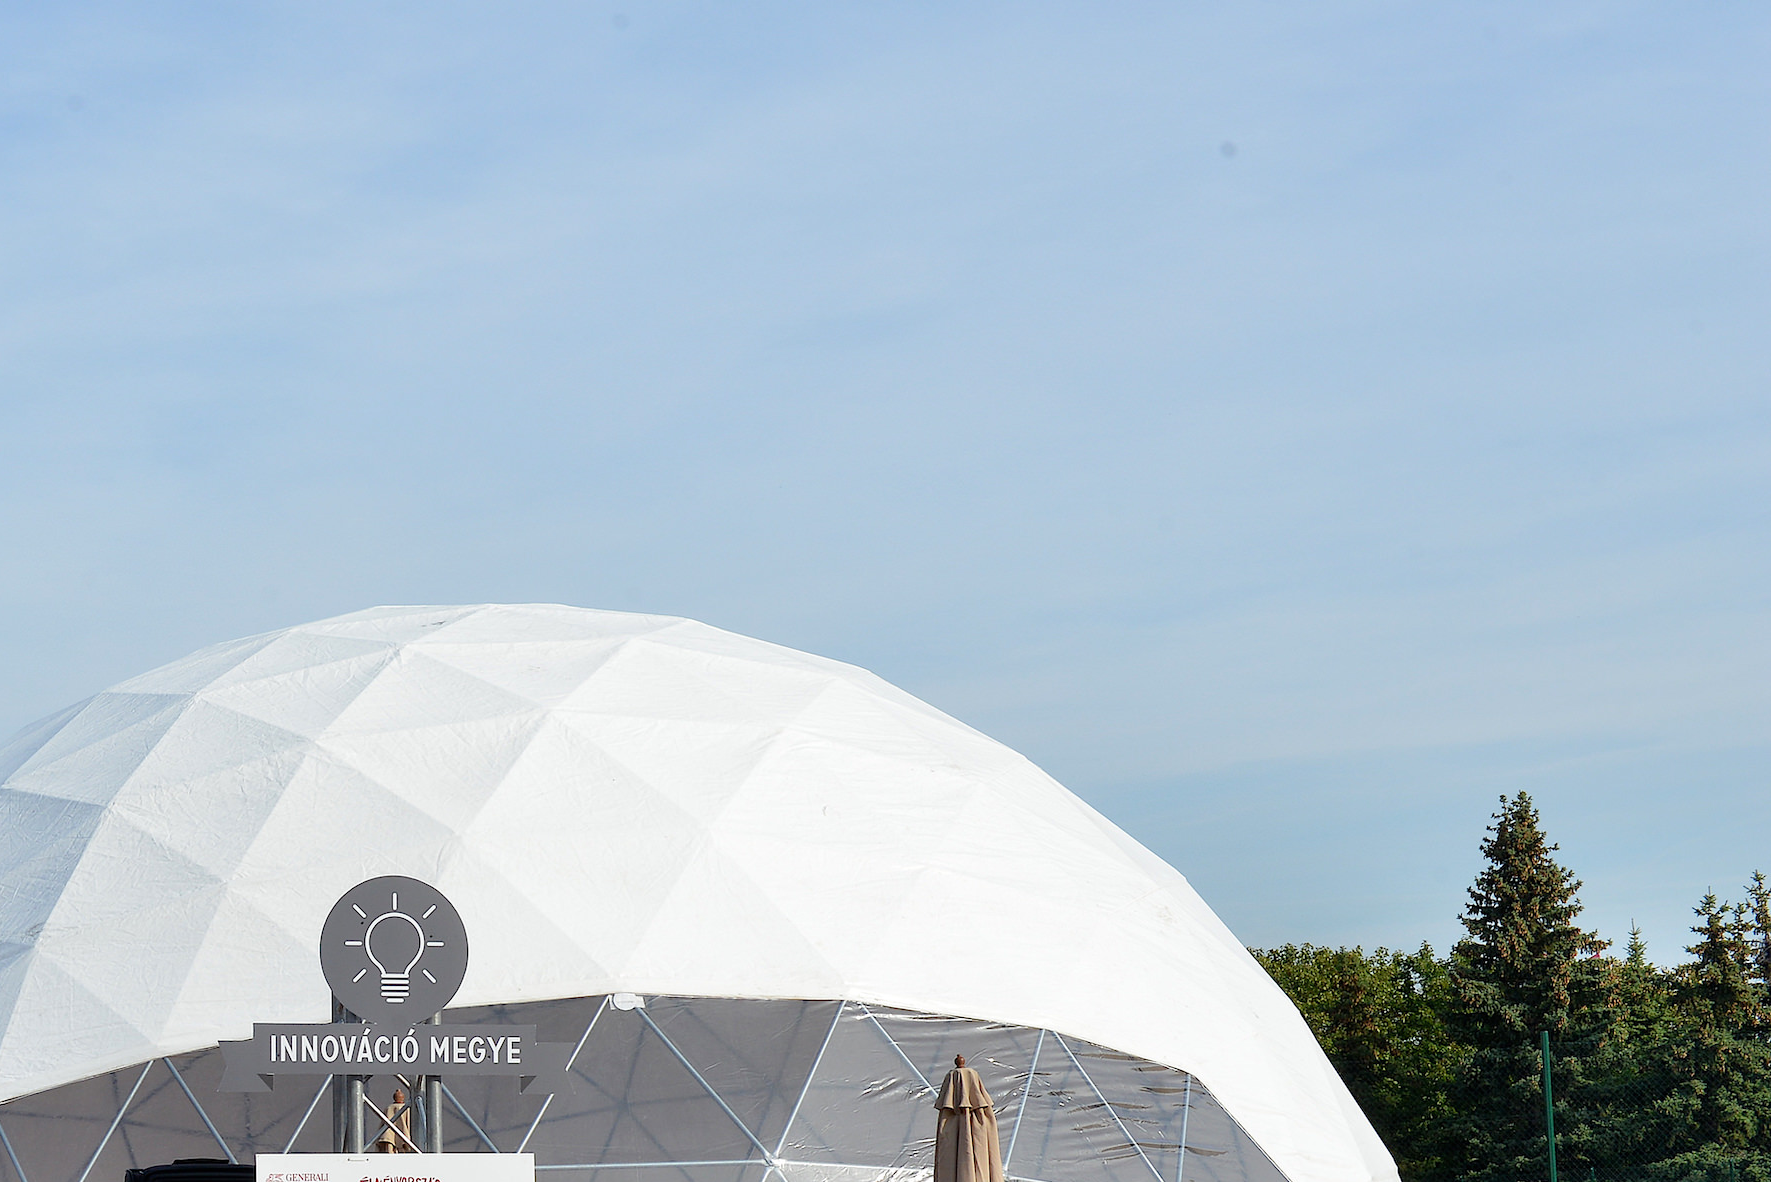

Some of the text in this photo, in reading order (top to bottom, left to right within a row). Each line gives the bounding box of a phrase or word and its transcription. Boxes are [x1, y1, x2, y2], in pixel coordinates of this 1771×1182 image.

[270, 1028, 521, 1064] INNOVÁCIÓ MEGYE
[285, 1173, 329, 1182] GENERALI
